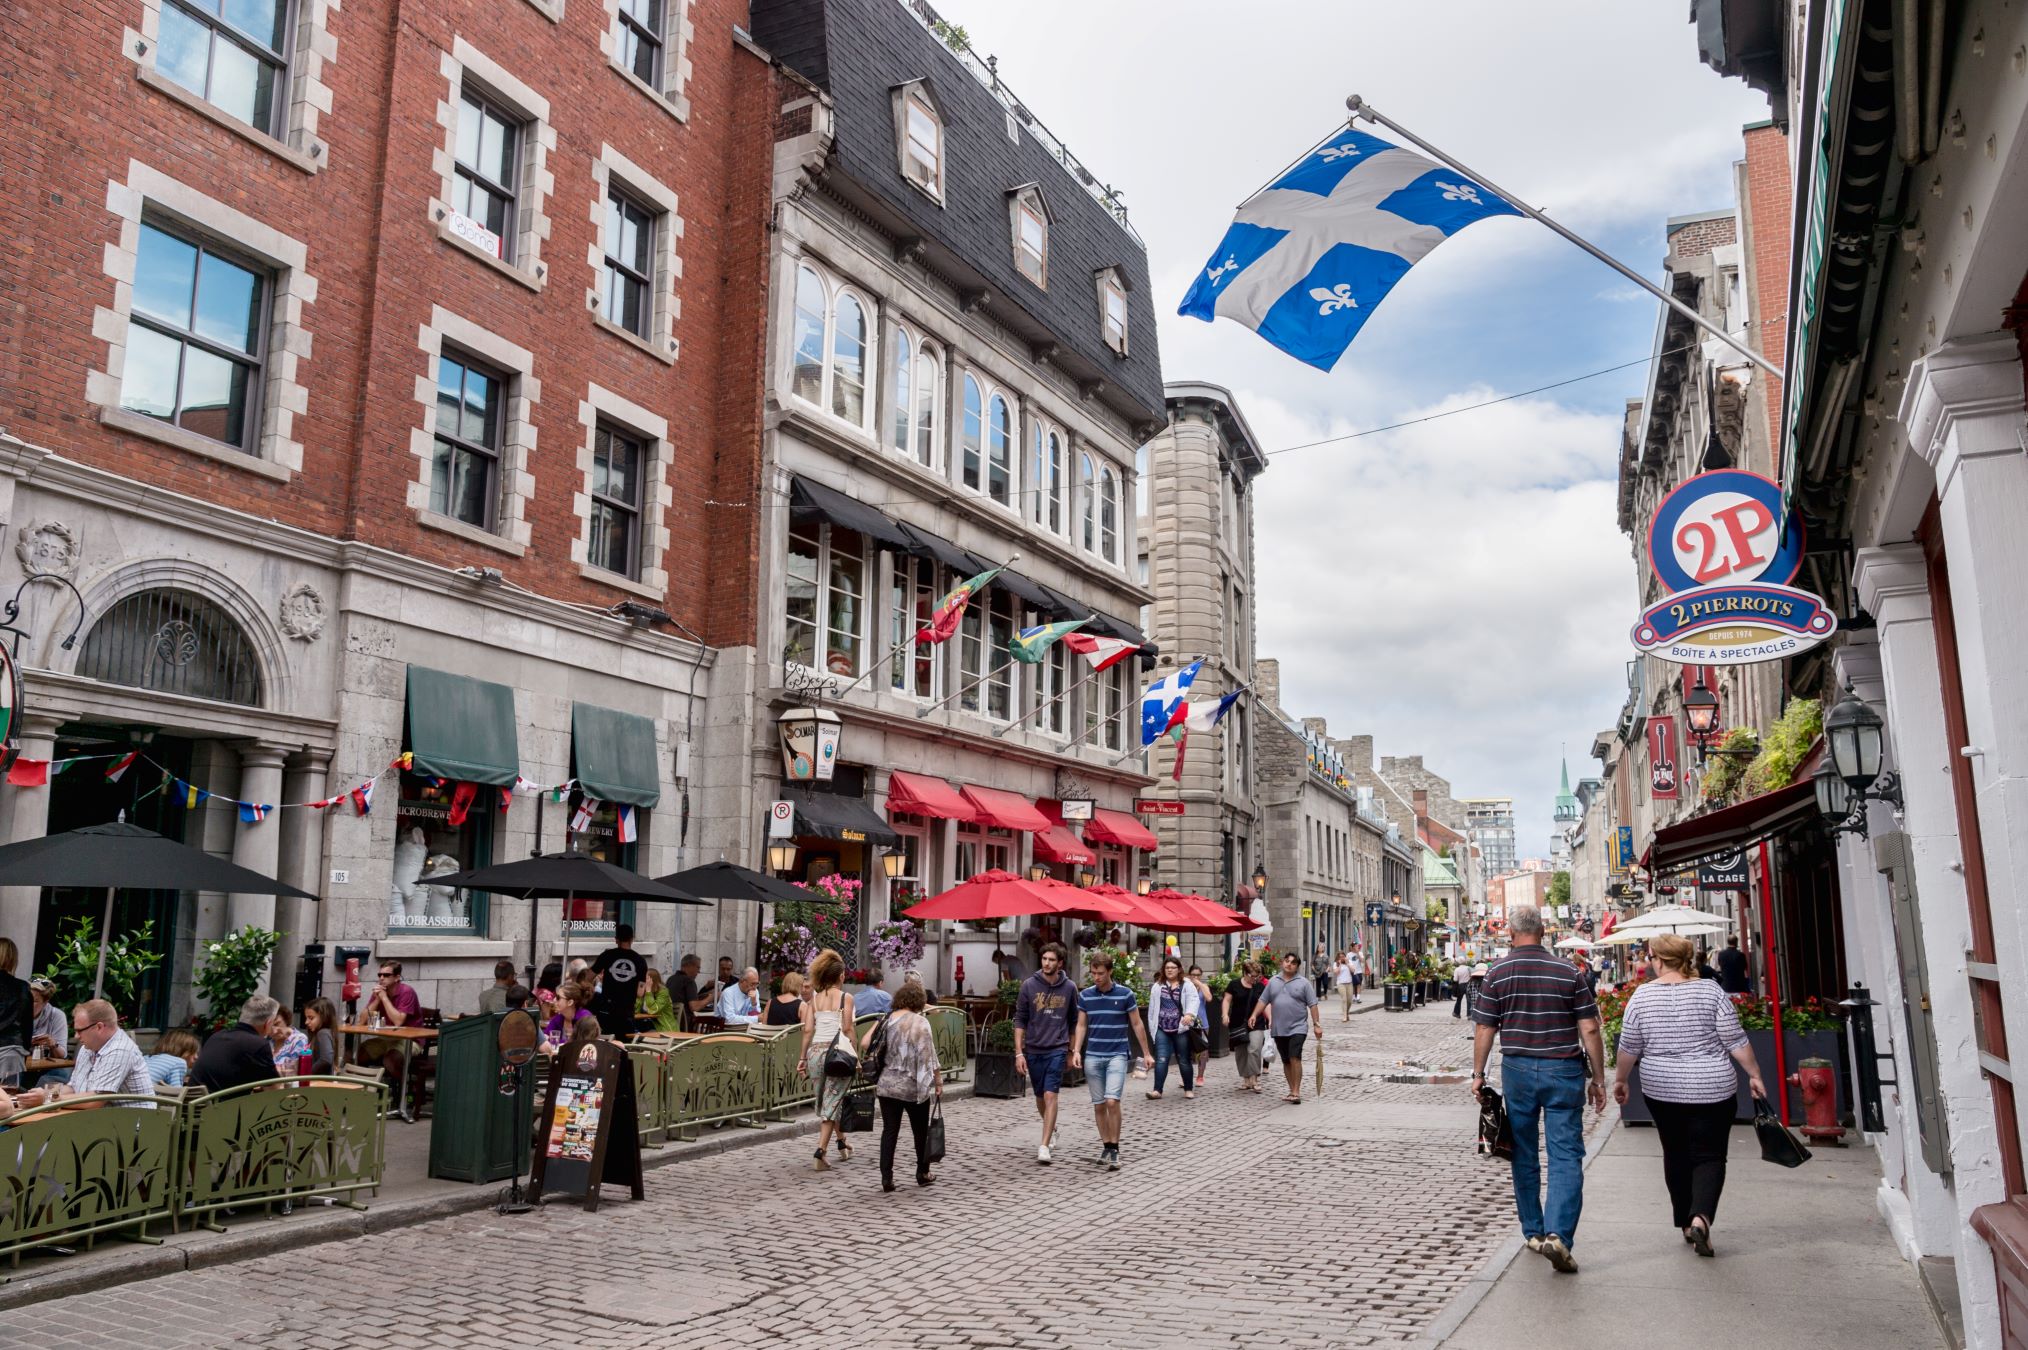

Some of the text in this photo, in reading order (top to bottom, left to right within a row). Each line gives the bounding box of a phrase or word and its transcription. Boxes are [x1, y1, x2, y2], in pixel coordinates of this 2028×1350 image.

[1676, 498, 1773, 585] 2P
[1670, 596, 1794, 627] 2 PIERROTS
[1708, 630, 1753, 641] DEPUIS 1974
[1708, 648, 1717, 659] À
[1720, 639, 1796, 659] SPECTACLES
[335, 872, 345, 881] 105
[1702, 874, 1746, 883] LA CAGE
[389, 914, 470, 927] ICROBRASSERIE
[256, 1117, 327, 1138] BRASEURS
